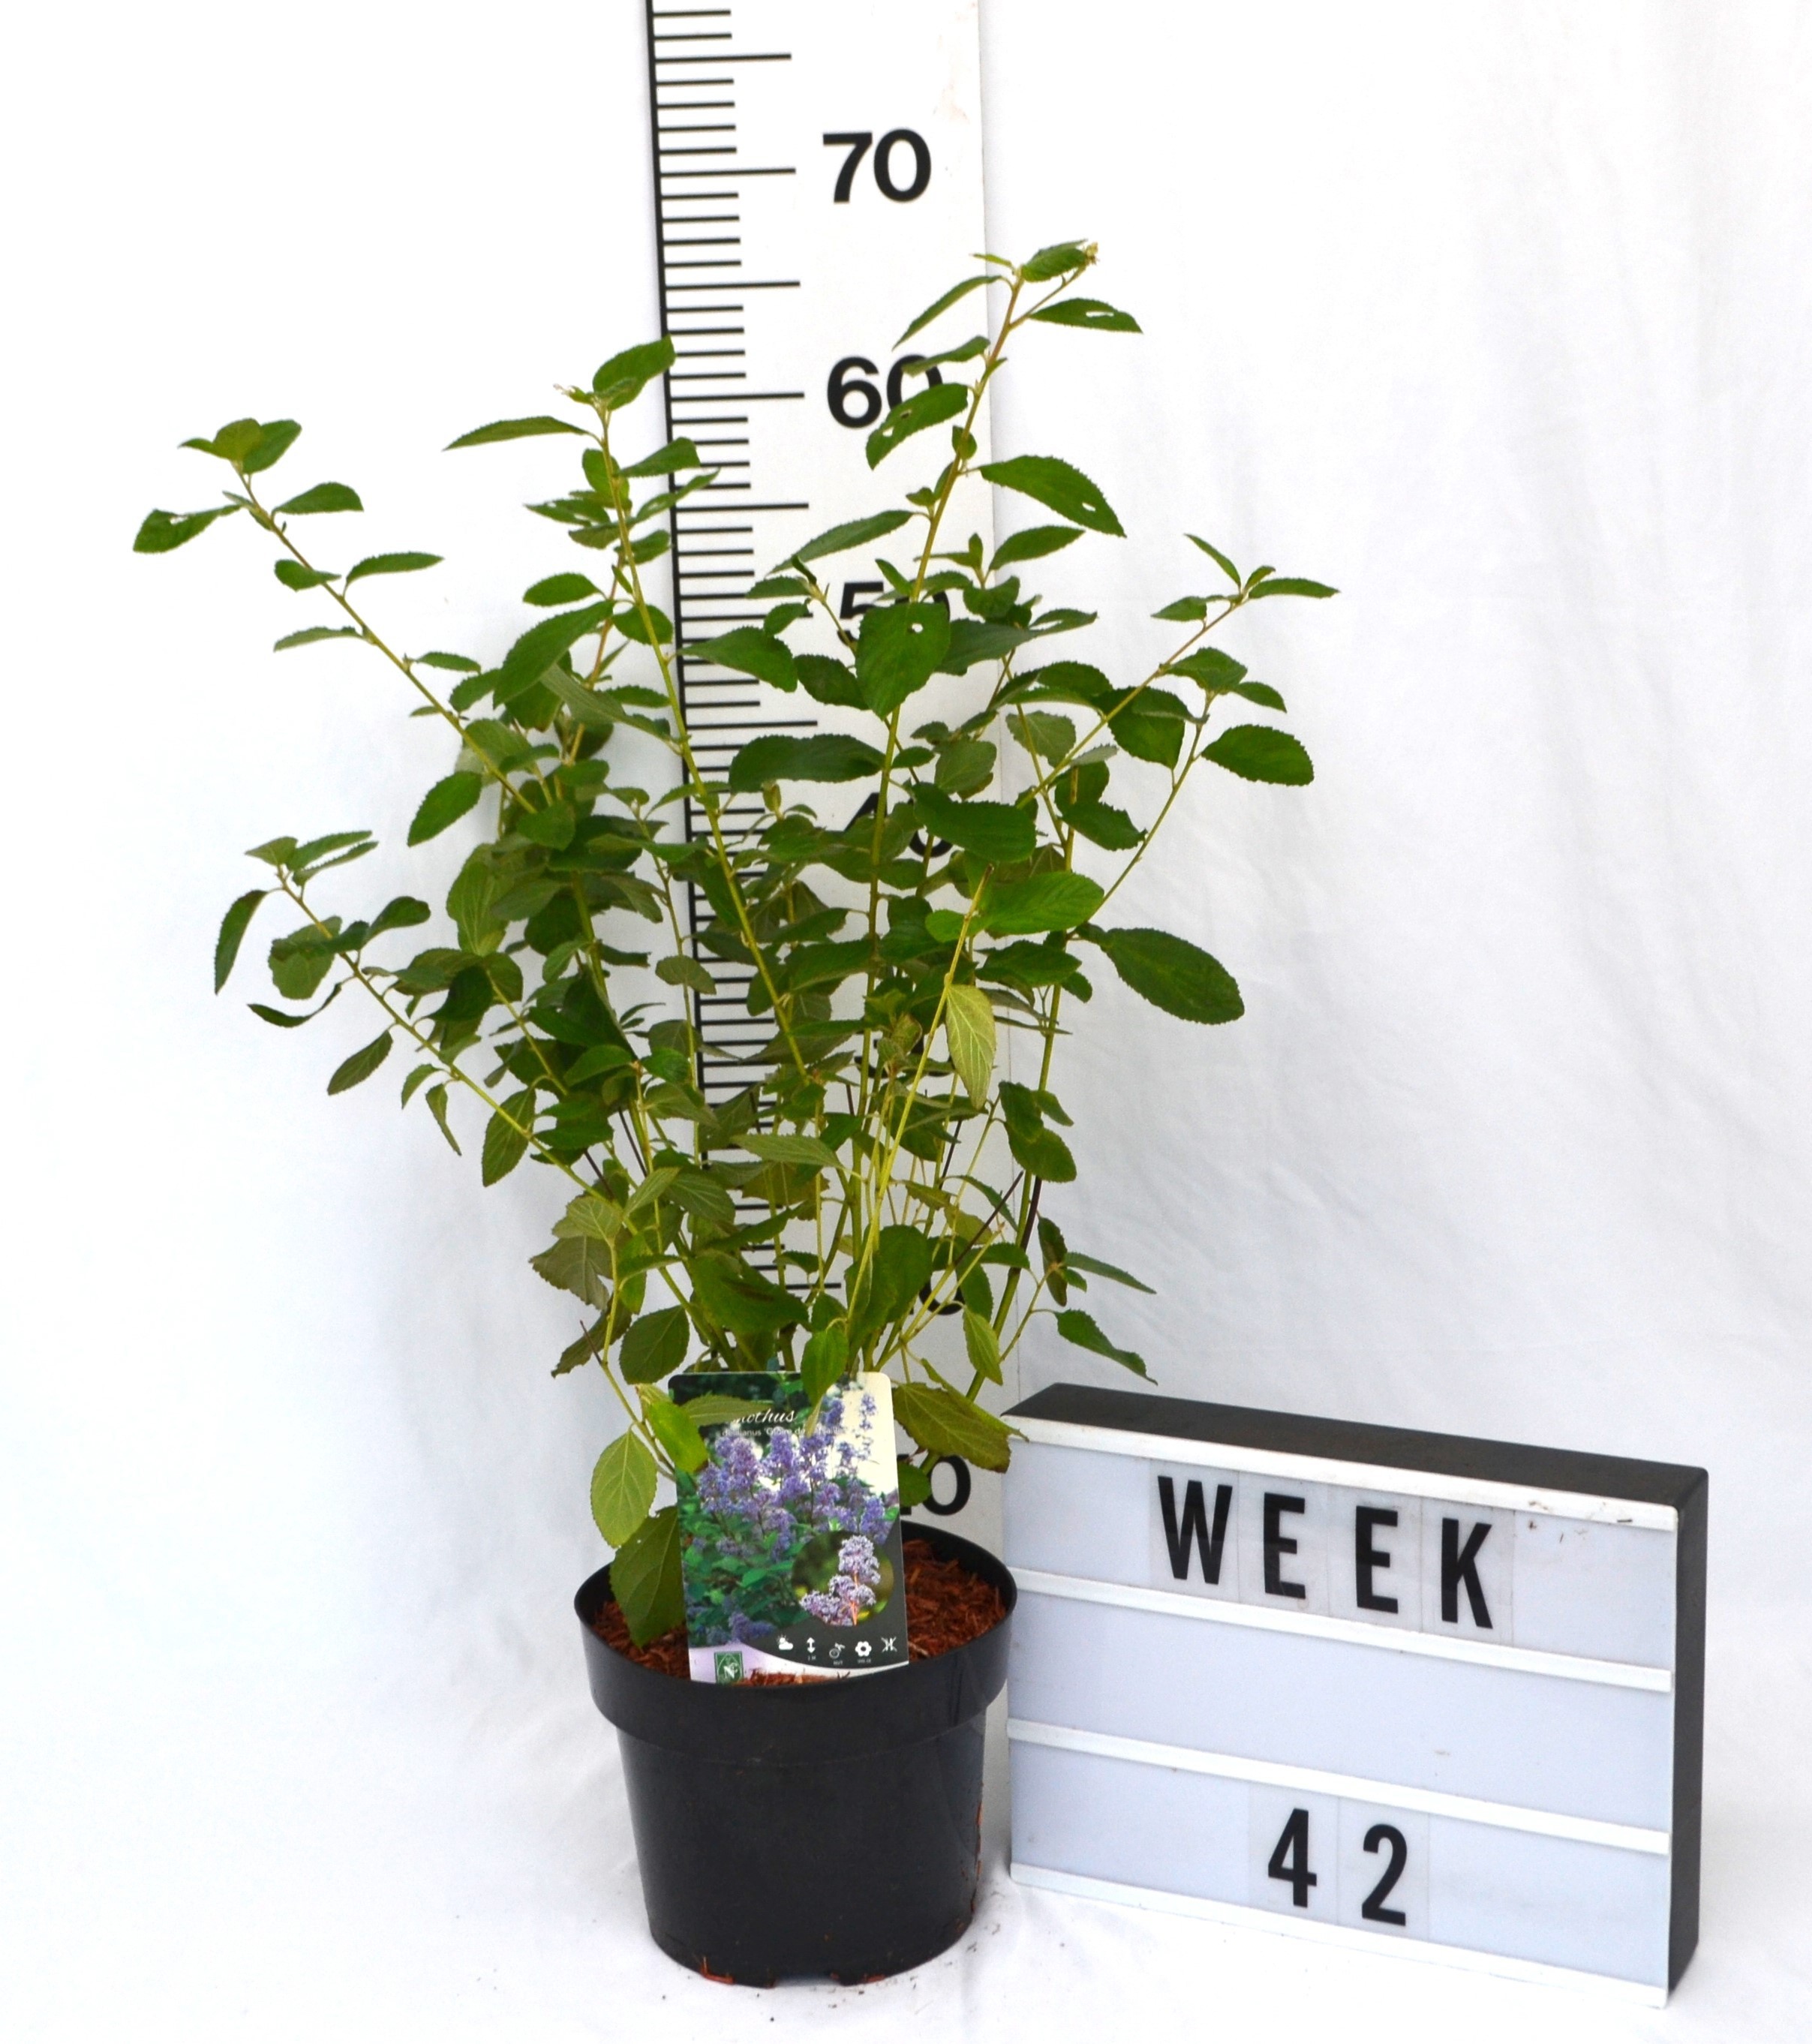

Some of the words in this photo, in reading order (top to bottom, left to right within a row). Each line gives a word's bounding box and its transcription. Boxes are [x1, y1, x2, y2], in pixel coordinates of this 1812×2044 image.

[823, 128, 931, 203] 70
[1157, 1476, 1493, 1630] WEEK
[1267, 1808, 1408, 1926] 42
